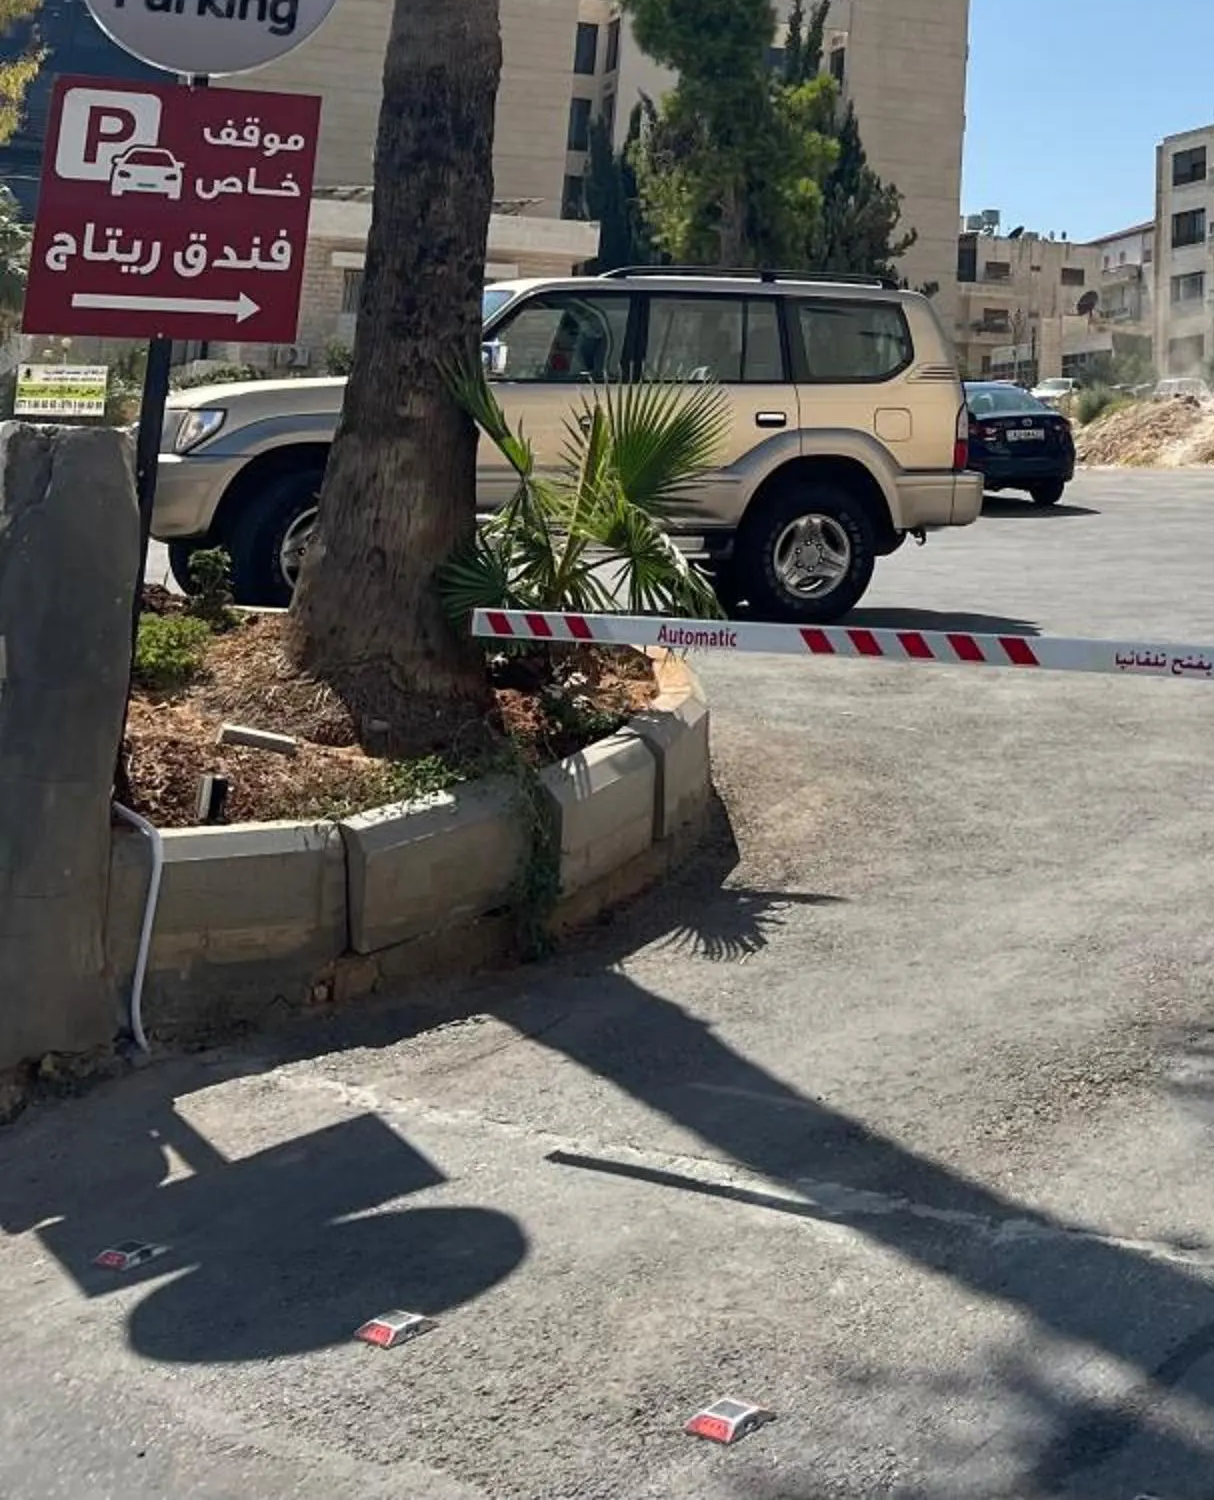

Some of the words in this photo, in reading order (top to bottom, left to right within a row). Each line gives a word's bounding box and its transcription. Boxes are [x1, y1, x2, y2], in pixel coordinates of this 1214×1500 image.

[82, 105, 137, 165] P
[203, 117, 305, 157] موقف
[195, 167, 302, 200] خاص
[45, 222, 162, 275] ريتاج
[173, 228, 293, 277] فندق
[657, 623, 738, 647] Automatic
[1171, 653, 1213, 677] يفتح
